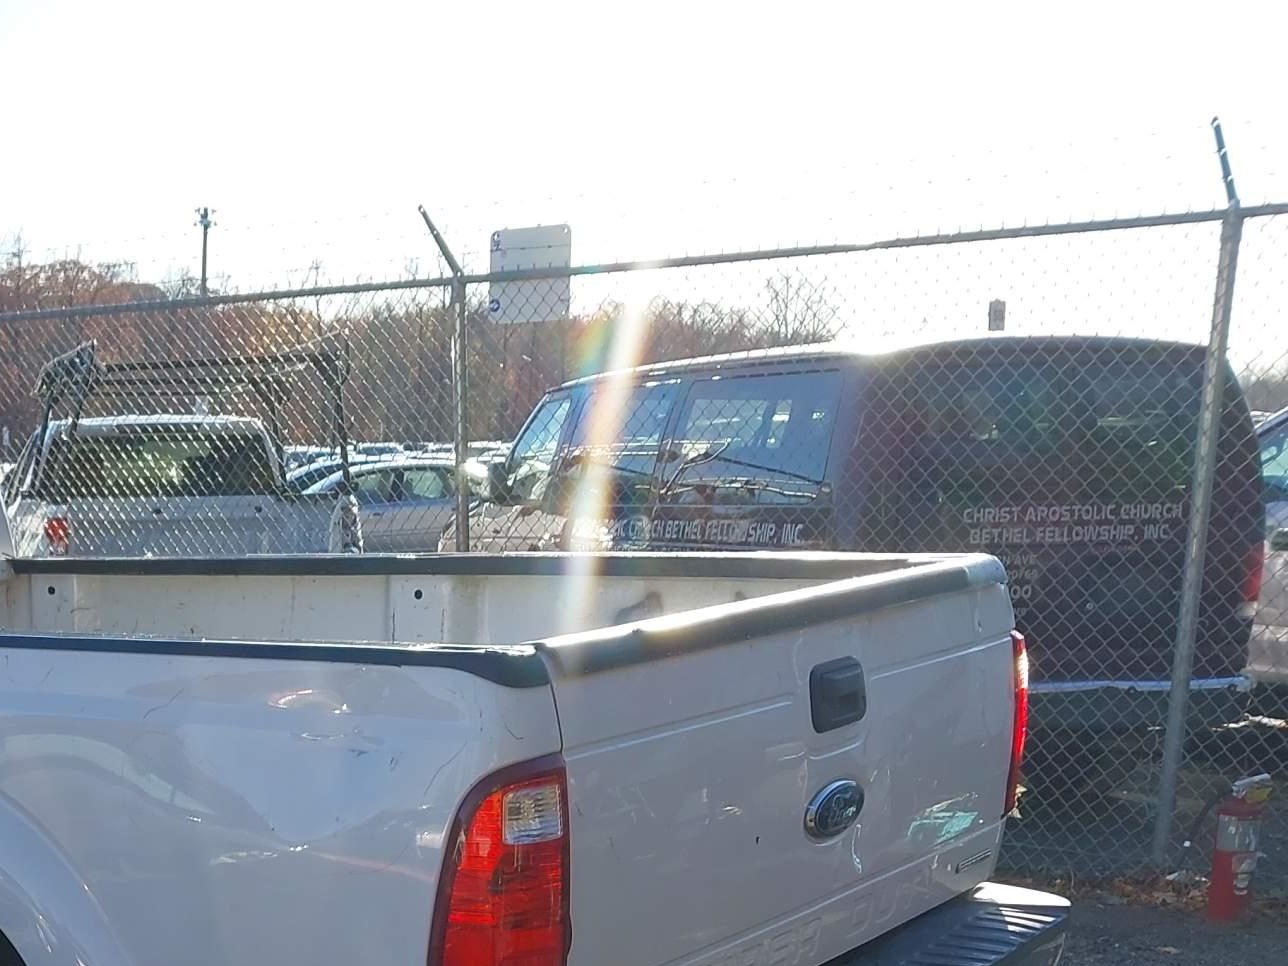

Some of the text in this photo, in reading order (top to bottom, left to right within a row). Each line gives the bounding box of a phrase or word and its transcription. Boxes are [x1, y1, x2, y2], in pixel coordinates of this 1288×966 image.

[963, 502, 1183, 523] CHRIST APOSTOLIC CHURCH
[629, 518, 665, 538] CHCH
[665, 519, 704, 540] BETHEL
[969, 527, 1035, 544] BETHEL
